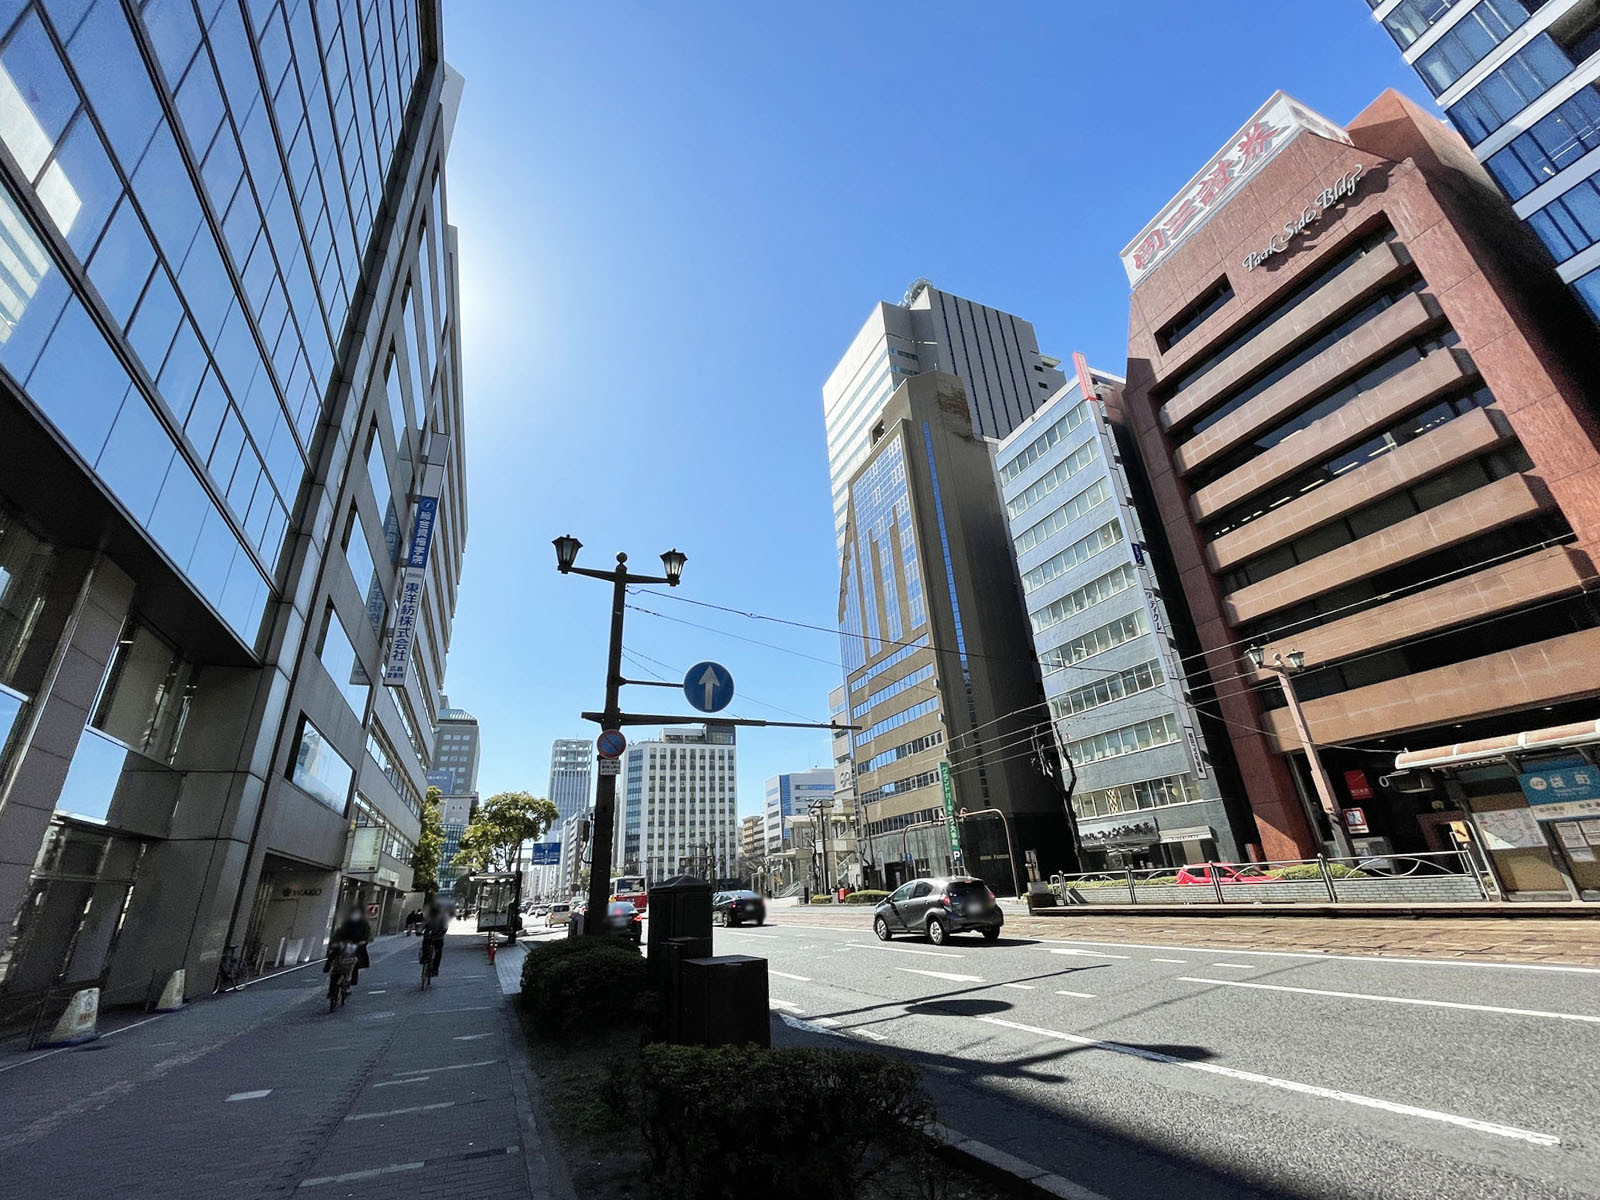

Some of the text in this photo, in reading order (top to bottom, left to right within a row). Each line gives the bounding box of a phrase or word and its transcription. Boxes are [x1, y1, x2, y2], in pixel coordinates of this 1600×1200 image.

[1242, 163, 1364, 272] Park Side Bldg.
[391, 582, 421, 662] 東洋紡株式会社
[953, 850, 961, 861] P
